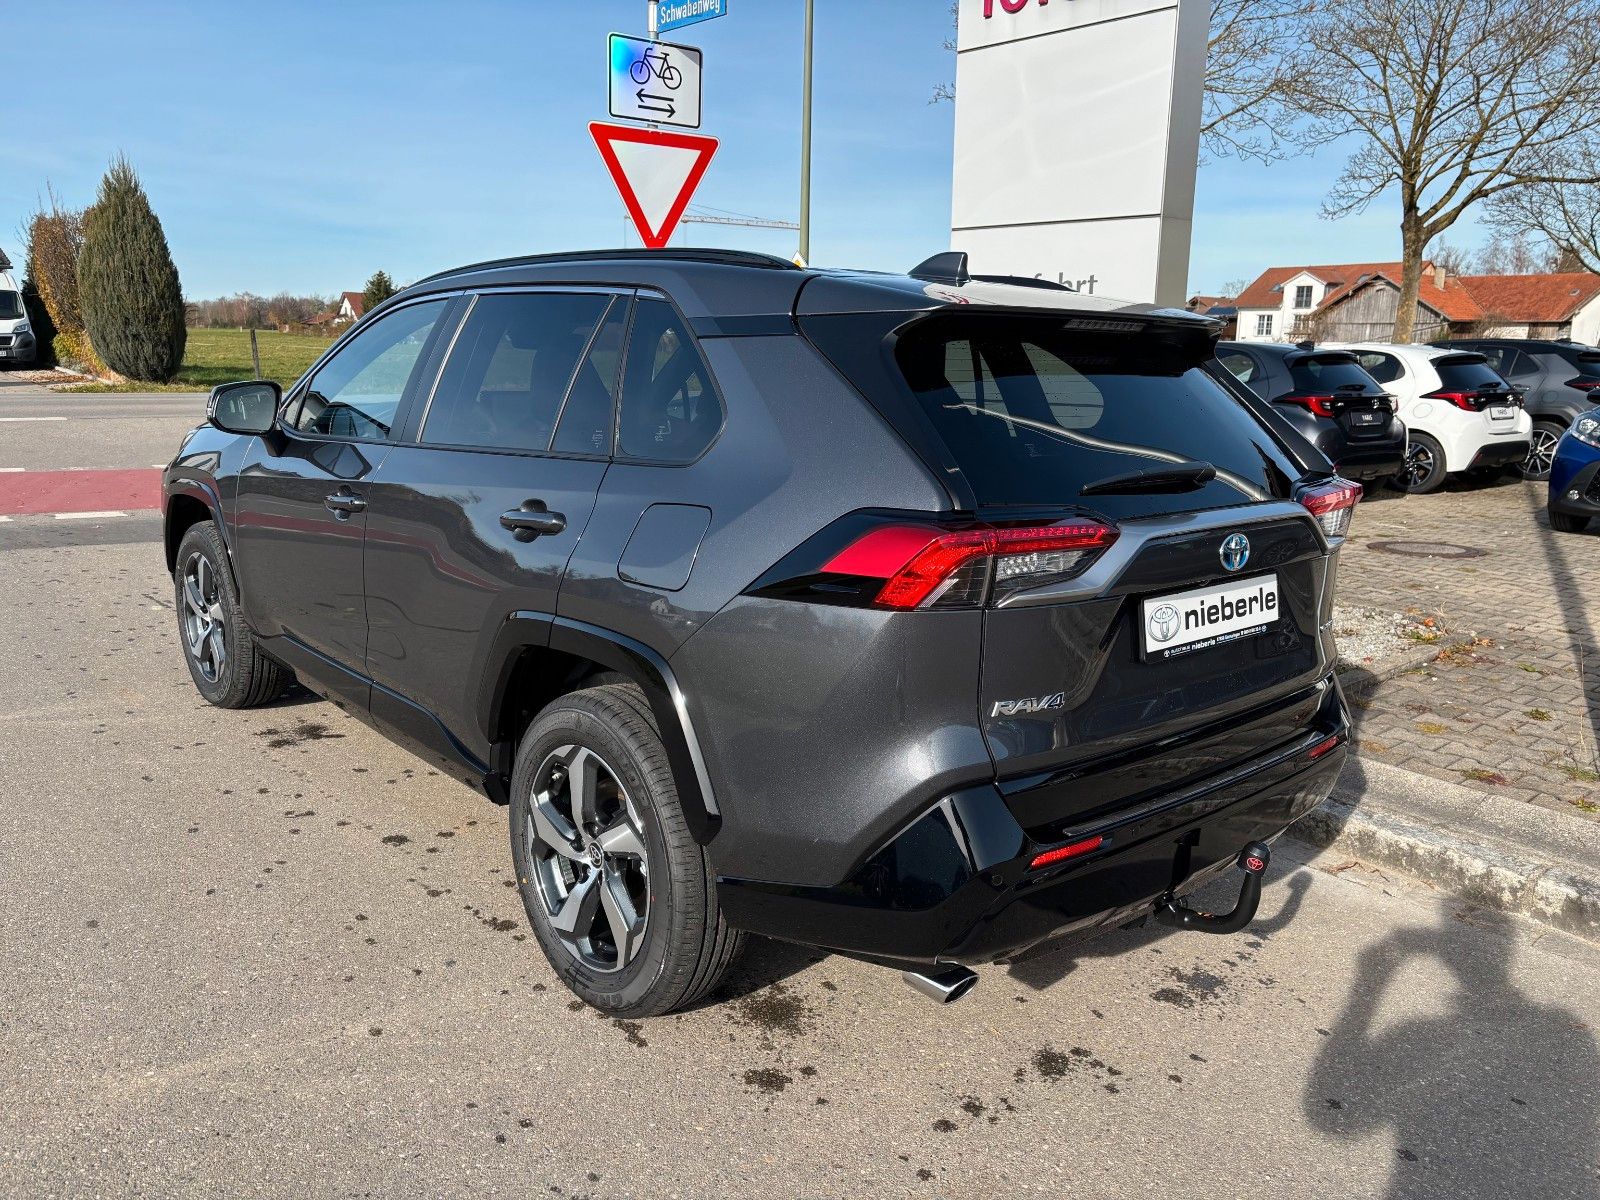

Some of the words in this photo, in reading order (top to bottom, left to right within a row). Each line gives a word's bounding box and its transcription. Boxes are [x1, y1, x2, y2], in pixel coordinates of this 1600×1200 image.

[660, 0, 720, 24] Schwabenweg
[1184, 587, 1277, 630] nieberle
[991, 691, 1065, 718] RAV4
